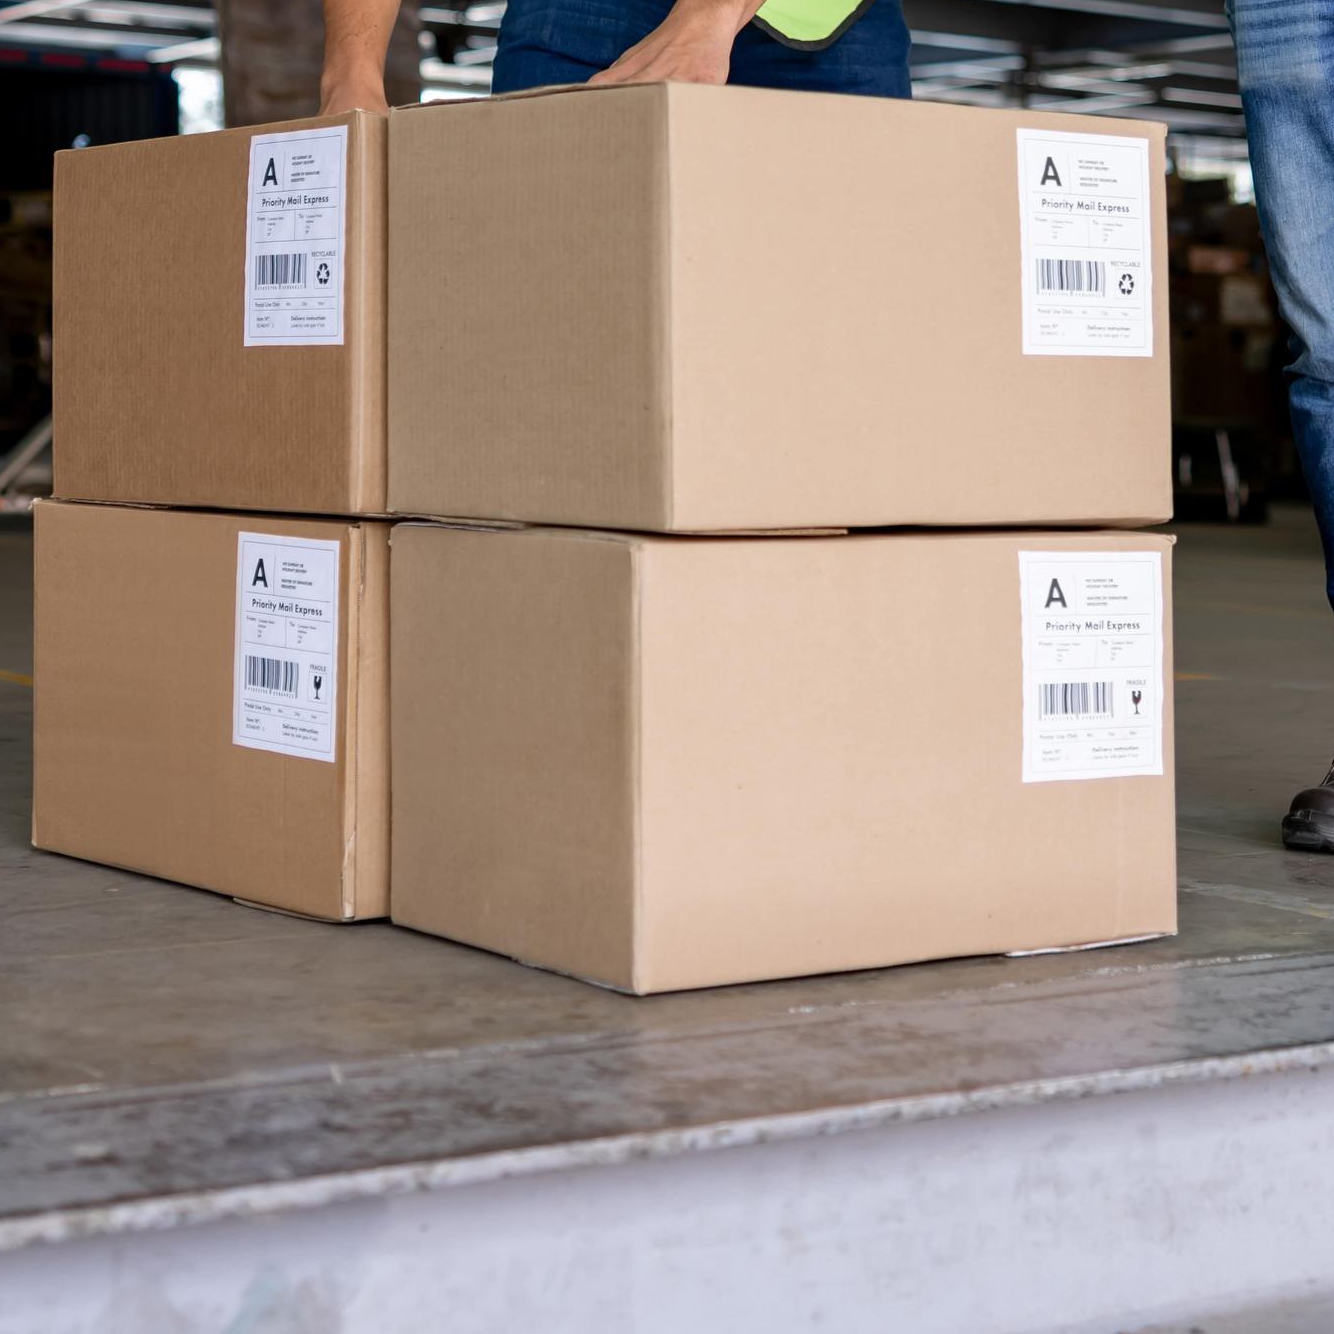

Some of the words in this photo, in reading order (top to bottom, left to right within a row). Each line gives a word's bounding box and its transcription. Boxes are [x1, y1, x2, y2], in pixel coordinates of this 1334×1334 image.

[262, 157, 278, 186] A
[1040, 156, 1062, 186] A
[262, 197, 286, 209] Priority
[286, 195, 302, 206] Mail
[303, 195, 329, 206] Express
[1041, 199, 1074, 211] Priority
[1077, 201, 1095, 211] Mail
[1097, 202, 1130, 213] Express
[252, 558, 269, 588] A
[1044, 578, 1068, 608] A
[252, 598, 277, 612] Priority
[278, 602, 293, 612] Mail
[294, 604, 323, 616] Express
[1045, 621, 1081, 634] Priority
[1085, 620, 1104, 630] Mail
[1106, 621, 1140, 633] Express
